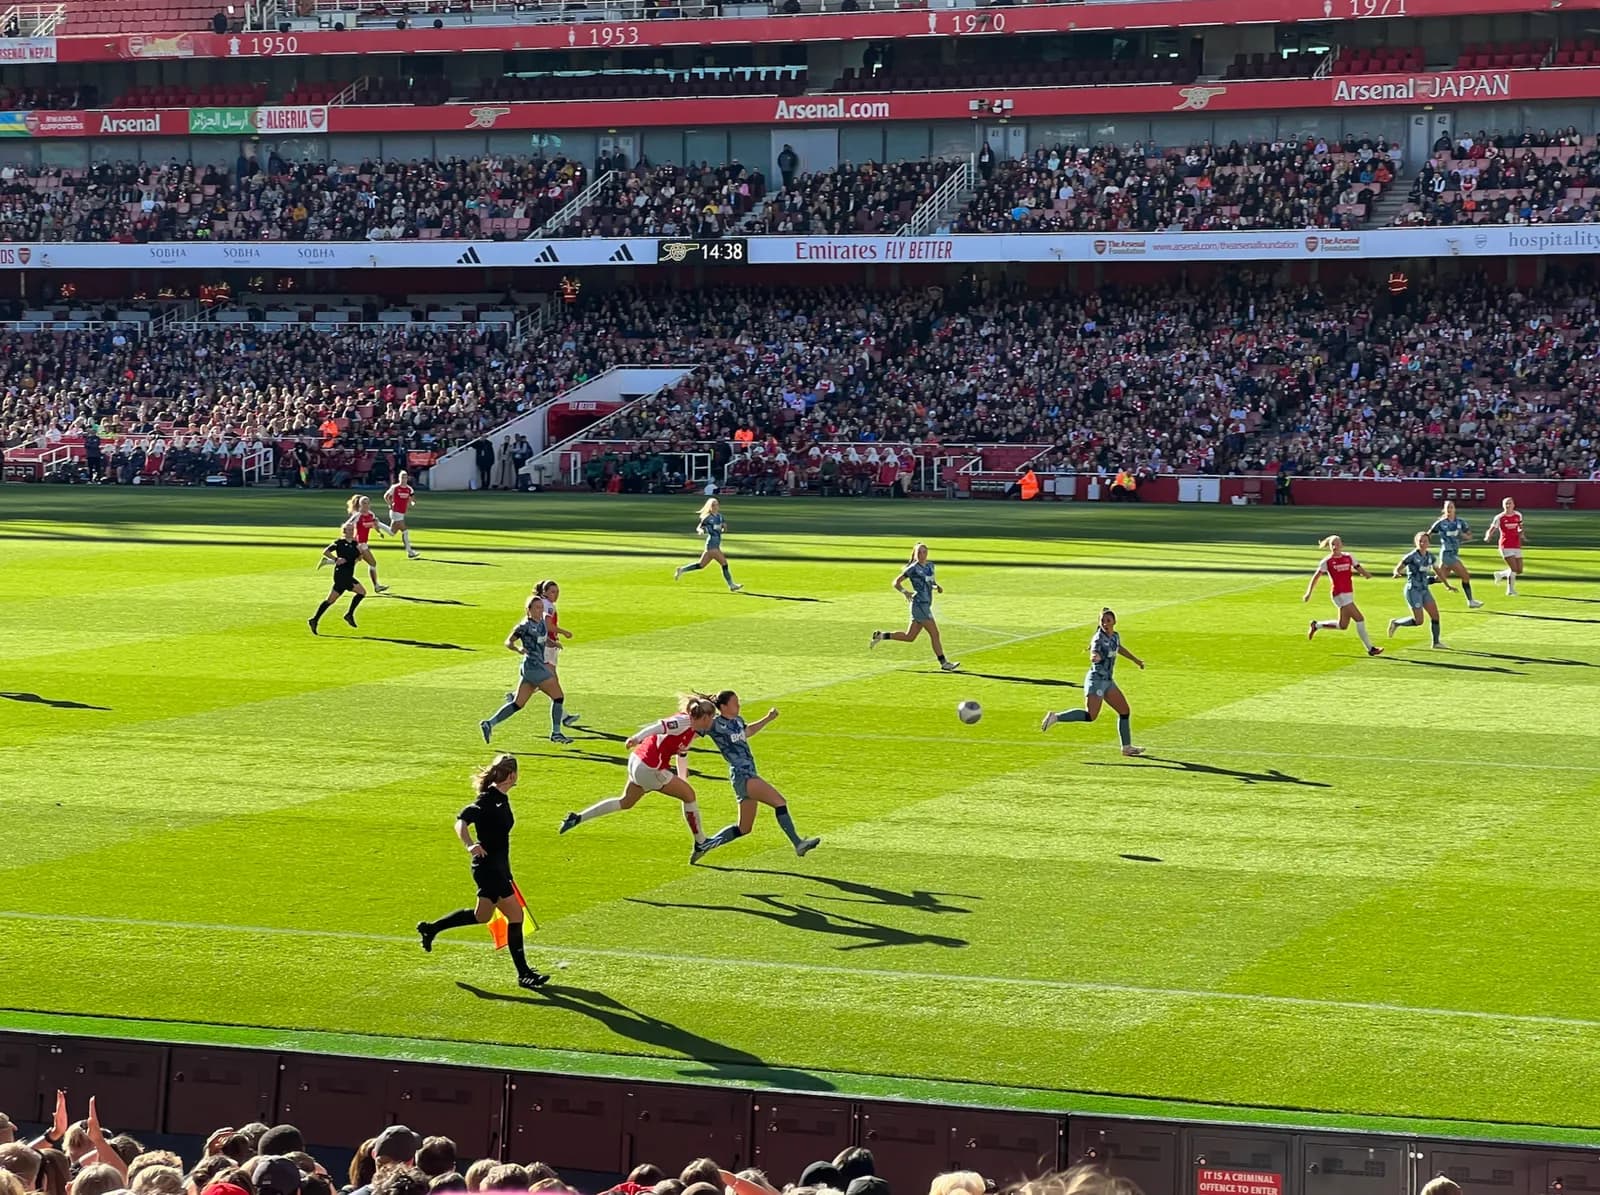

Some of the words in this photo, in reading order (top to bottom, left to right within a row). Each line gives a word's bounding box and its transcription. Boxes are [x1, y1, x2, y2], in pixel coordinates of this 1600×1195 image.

[1351, 0, 1406, 16] 1971
[590, 26, 639, 45] 1953
[29, 47, 53, 59] NEPAL
[251, 36, 298, 54] 1950
[1334, 78, 1414, 101] Arsenal
[1428, 74, 1510, 98] JAPAN
[775, 98, 889, 120] Arsenal.com
[40, 122, 84, 130] SUPPORTERS
[100, 114, 161, 133] Arsenal
[266, 110, 308, 129] ALGERIA
[1121, 240, 1146, 248] Arsenal
[1335, 236, 1360, 244] Arsenal
[1508, 231, 1600, 250] hospitality
[150, 248, 187, 258] SOBHA
[223, 248, 260, 258] SOBHA
[297, 249, 335, 258] SOBHA
[701, 243, 743, 260] 14:38
[796, 241, 877, 260] Emirates
[885, 241, 906, 260] FLY
[909, 241, 953, 259] BETTER
[1203, 1171, 1212, 1180] IT
[1214, 1171, 1223, 1181] IS
[1223, 1172, 1231, 1181] A
[1232, 1173, 1274, 1184] CRIMINAL
[1199, 1182, 1236, 1193] OFFENCE
[1237, 1185, 1249, 1194] TO
[1250, 1186, 1278, 1195] ENTER
